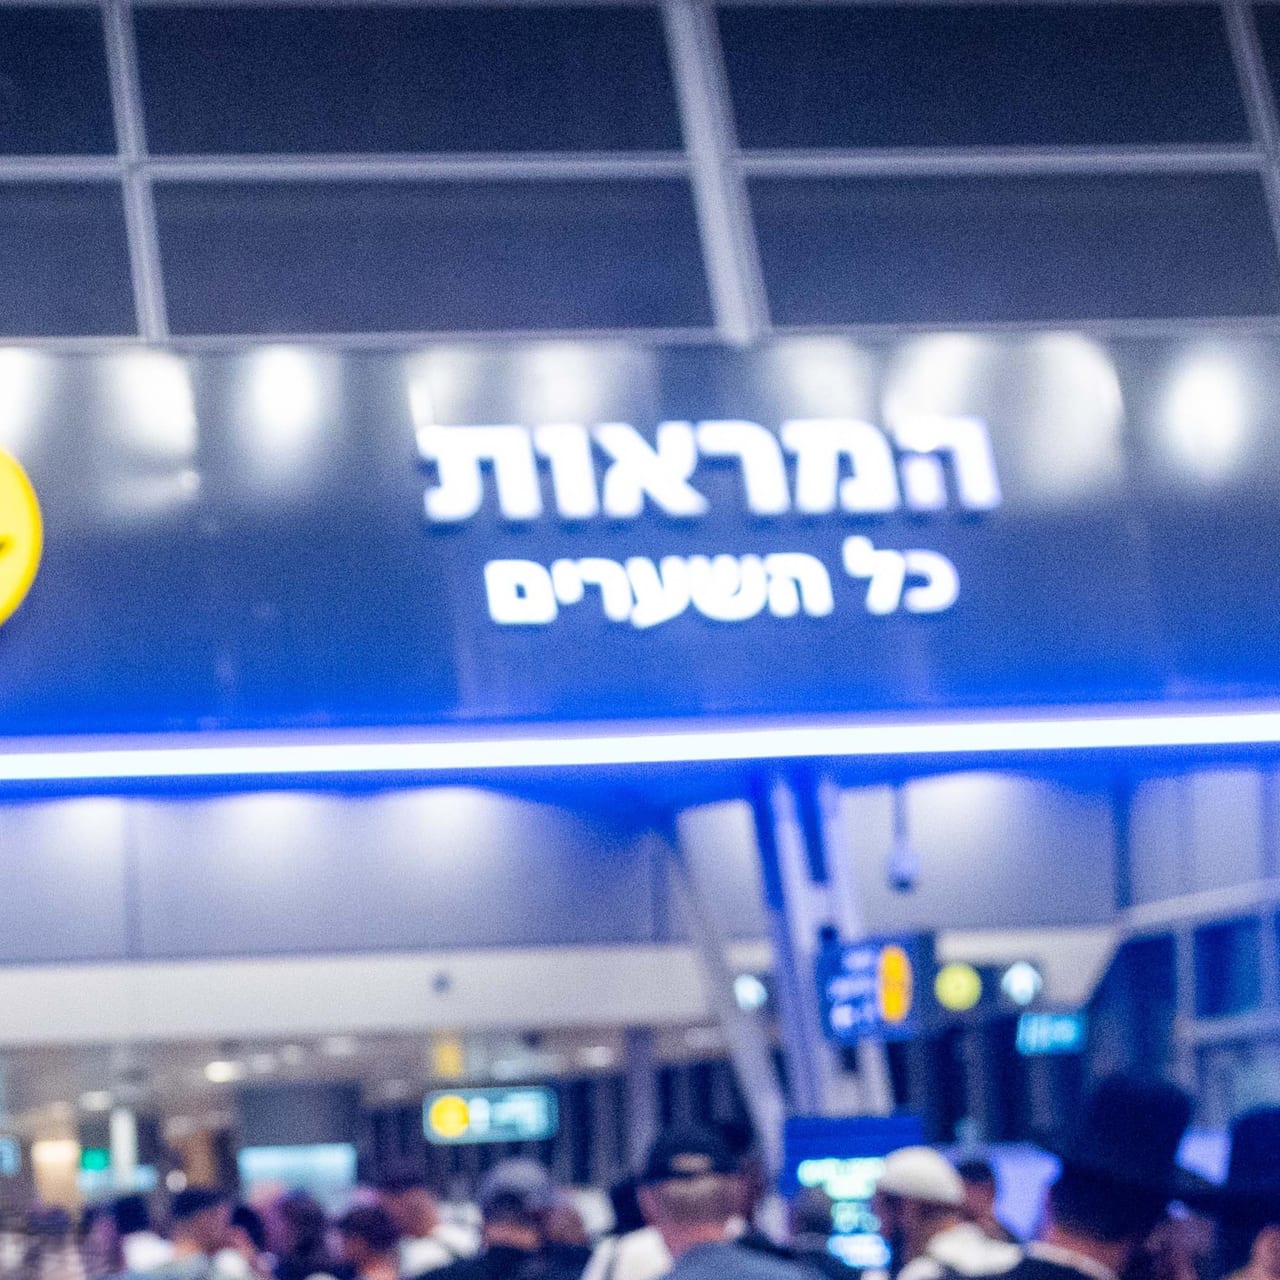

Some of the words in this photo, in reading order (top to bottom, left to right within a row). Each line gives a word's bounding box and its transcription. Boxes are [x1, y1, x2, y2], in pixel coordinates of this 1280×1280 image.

[417, 416, 1002, 521] המראות
[484, 553, 834, 628] השערים
[843, 536, 960, 614] כל
